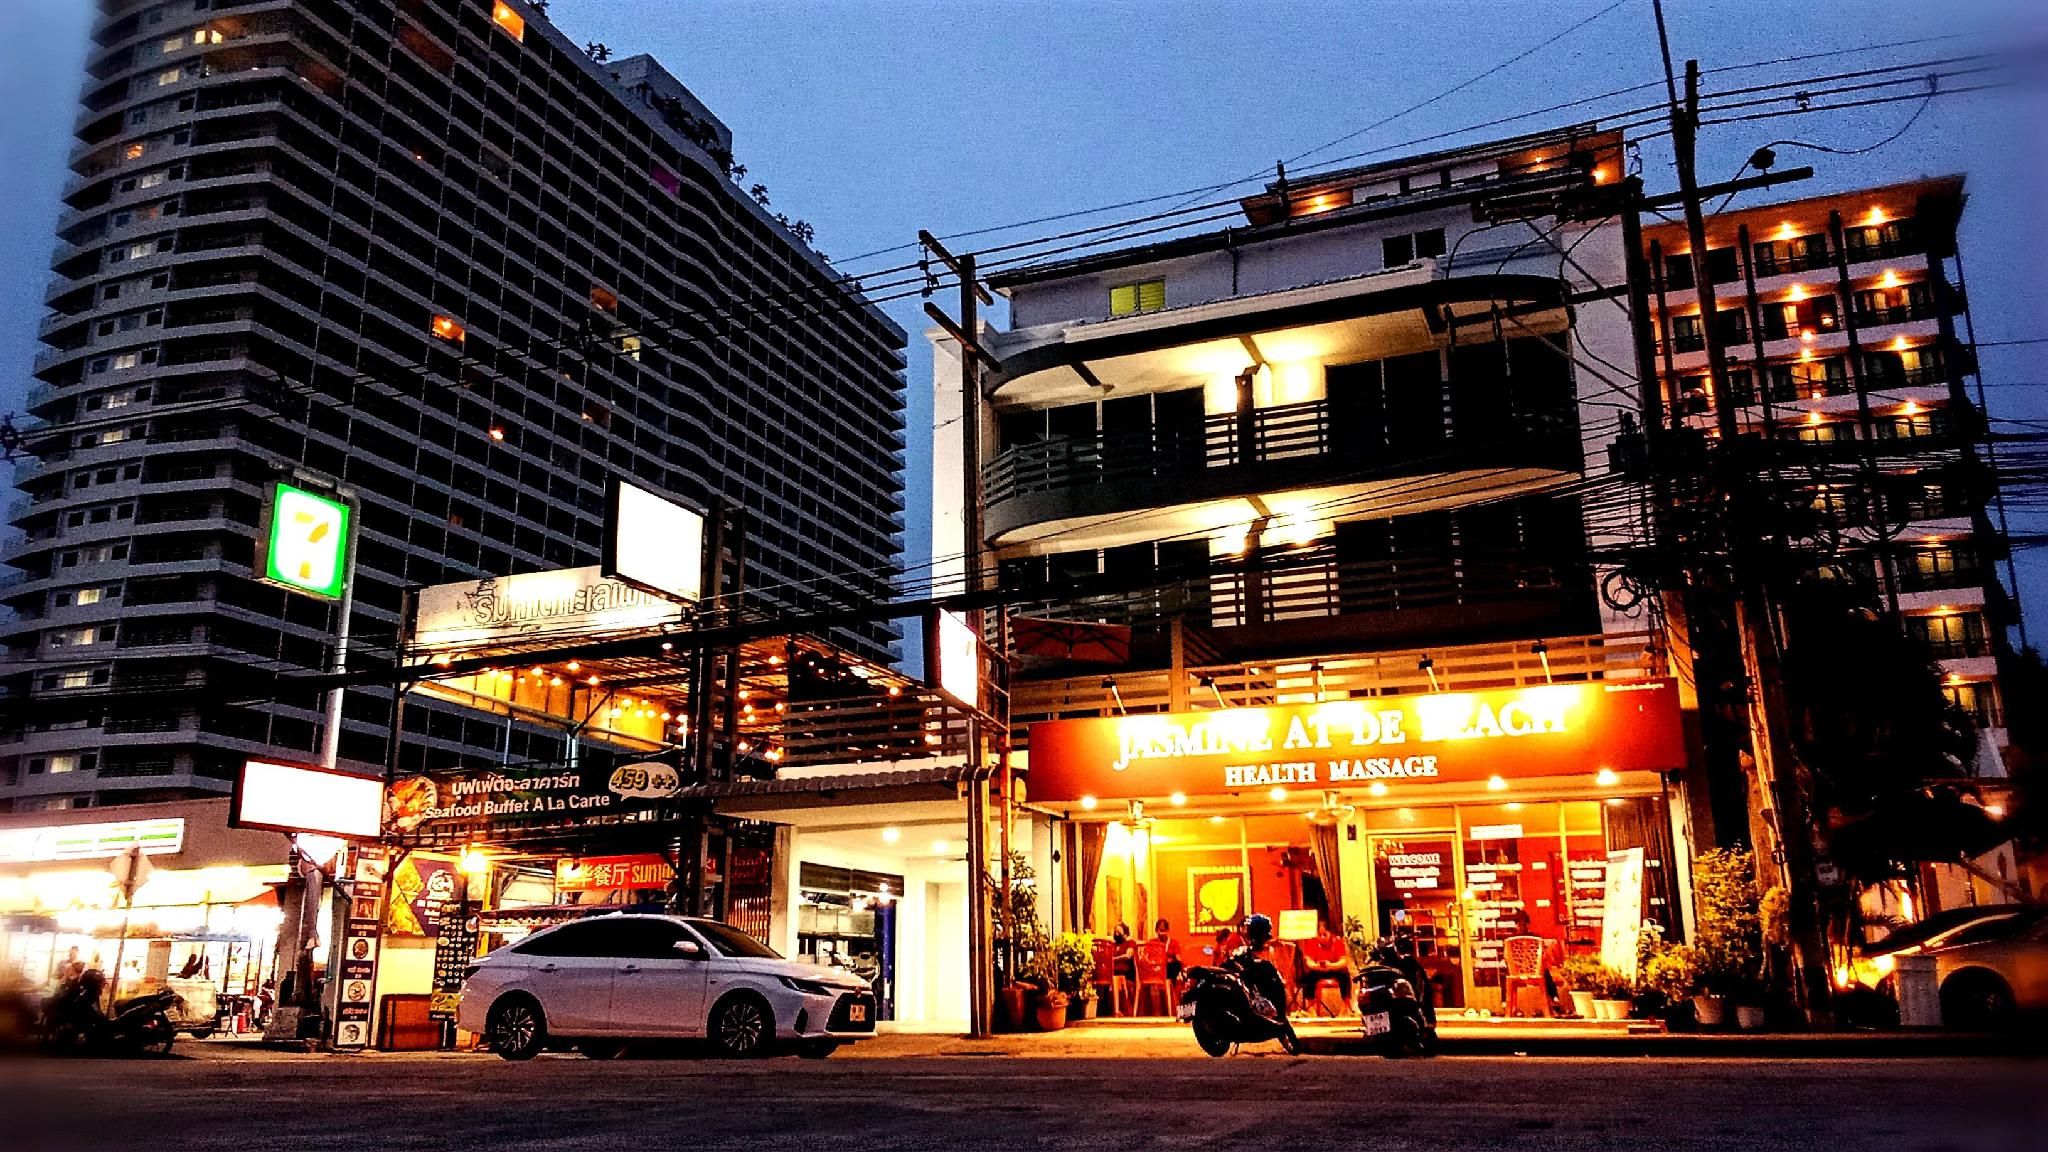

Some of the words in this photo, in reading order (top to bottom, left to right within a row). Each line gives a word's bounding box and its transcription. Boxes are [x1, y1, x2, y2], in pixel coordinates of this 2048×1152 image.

[1113, 714, 1273, 771] JASMINE
[1283, 713, 1332, 750] AT
[1351, 710, 1407, 746] DE
[611, 768, 647, 788] 459
[1225, 762, 1317, 786] HEALTH
[1329, 756, 1438, 781] MASSAGE
[425, 800, 482, 819] Seafood
[484, 799, 530, 815] Buffet
[533, 799, 544, 812] A
[548, 797, 566, 811] La
[569, 793, 610, 810] Carte
[1389, 853, 1441, 866] WELCOME
[558, 861, 630, 888] 华餐厅
